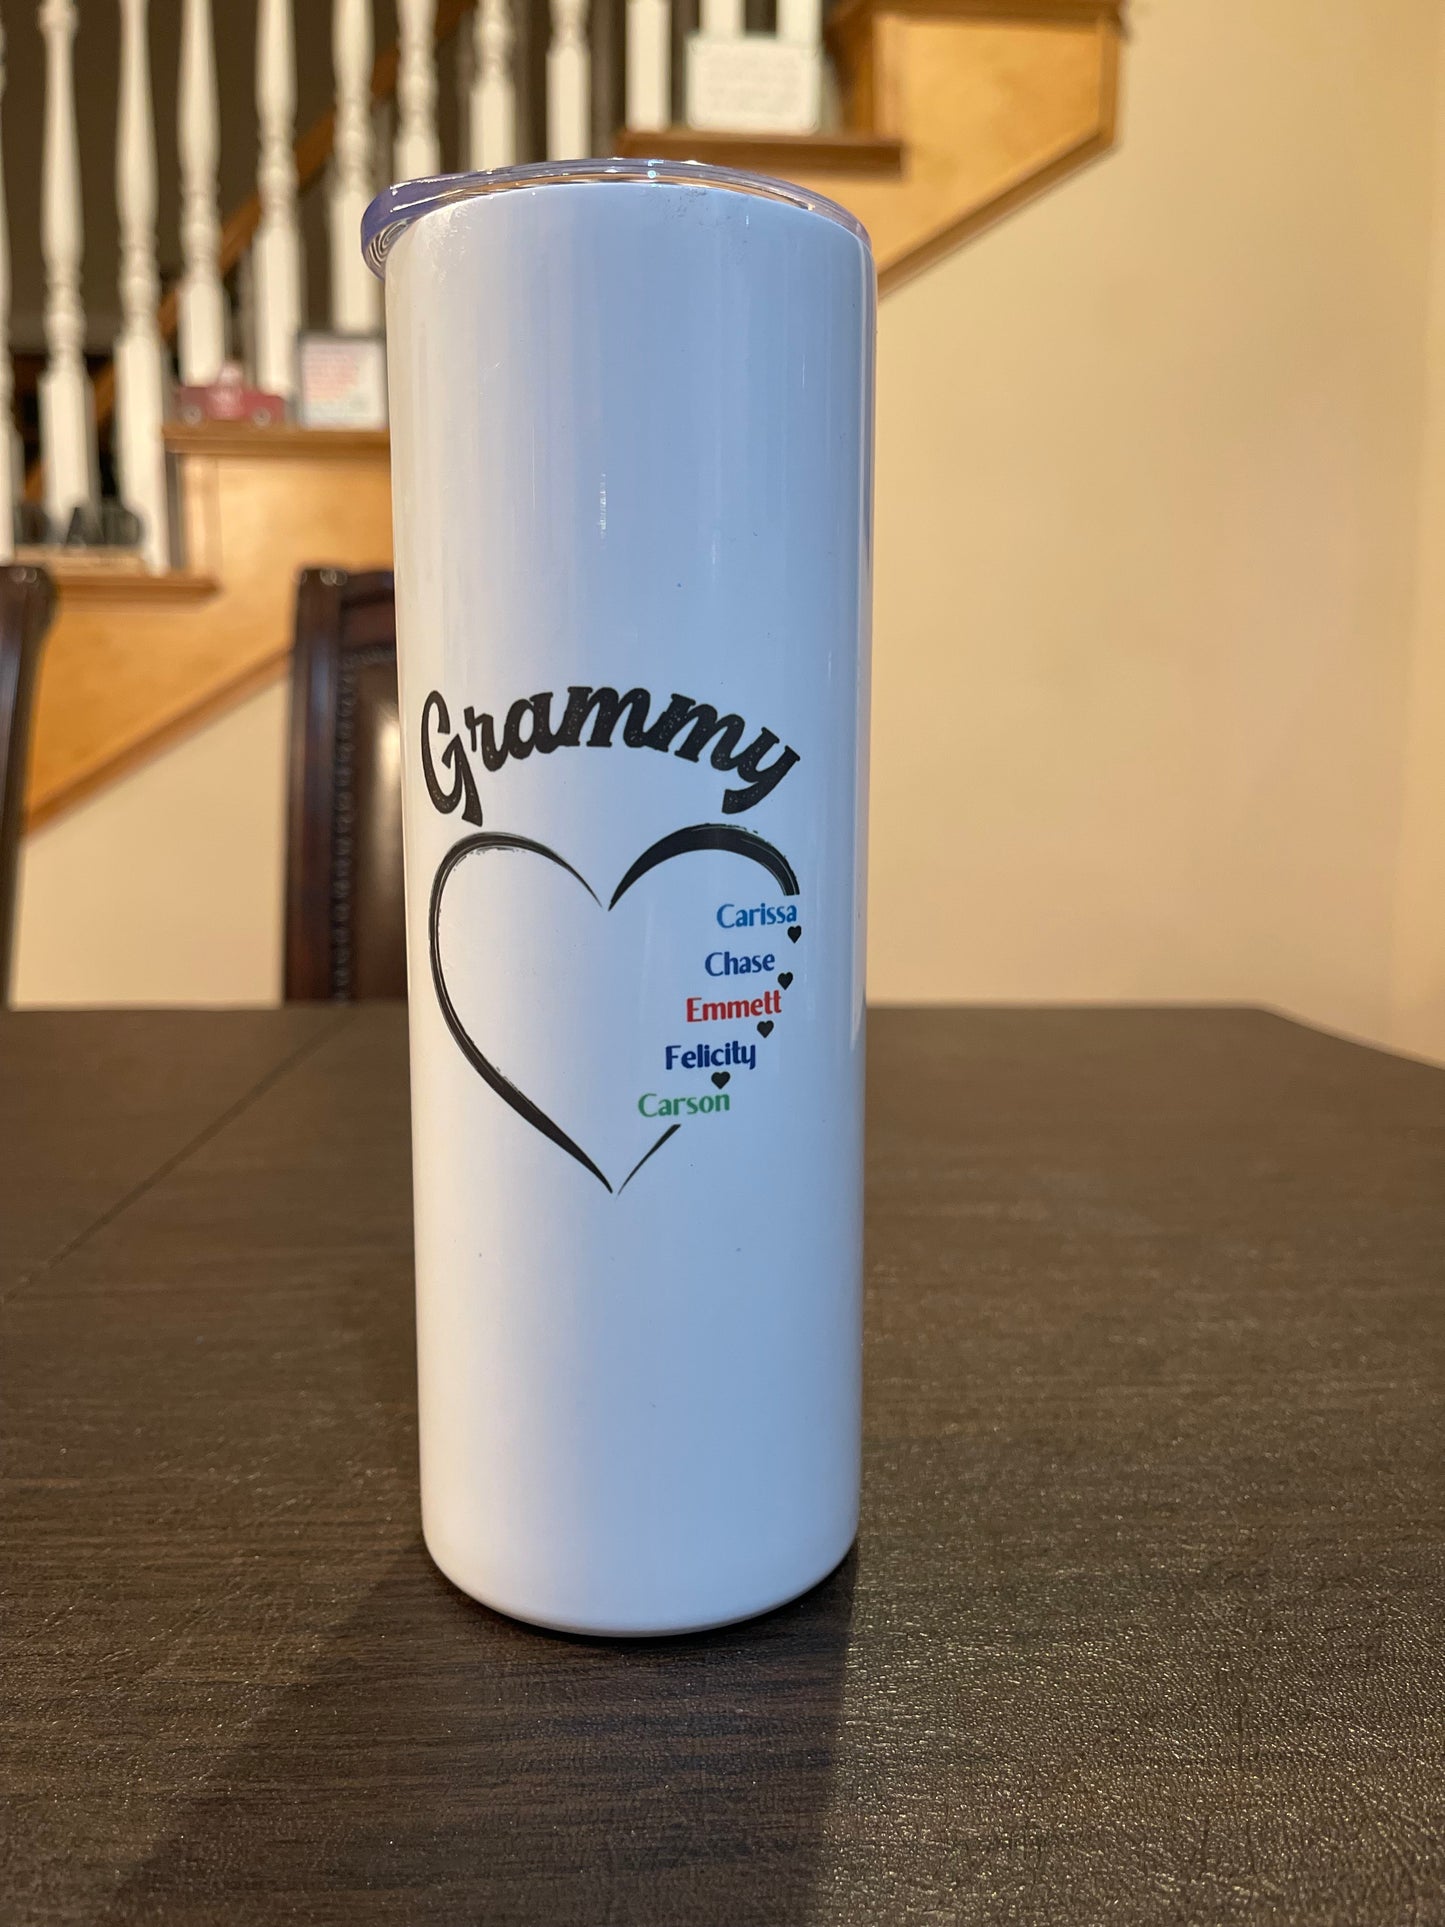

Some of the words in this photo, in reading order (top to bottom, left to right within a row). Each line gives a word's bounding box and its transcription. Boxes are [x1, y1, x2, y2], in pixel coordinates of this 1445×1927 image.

[421, 686, 801, 827] Grammy
[716, 903, 798, 929] Carissa
[704, 952, 776, 977] Chase
[686, 989, 783, 1023] Emmett
[665, 1040, 757, 1070] Felicity
[638, 1092, 730, 1118] Carson
